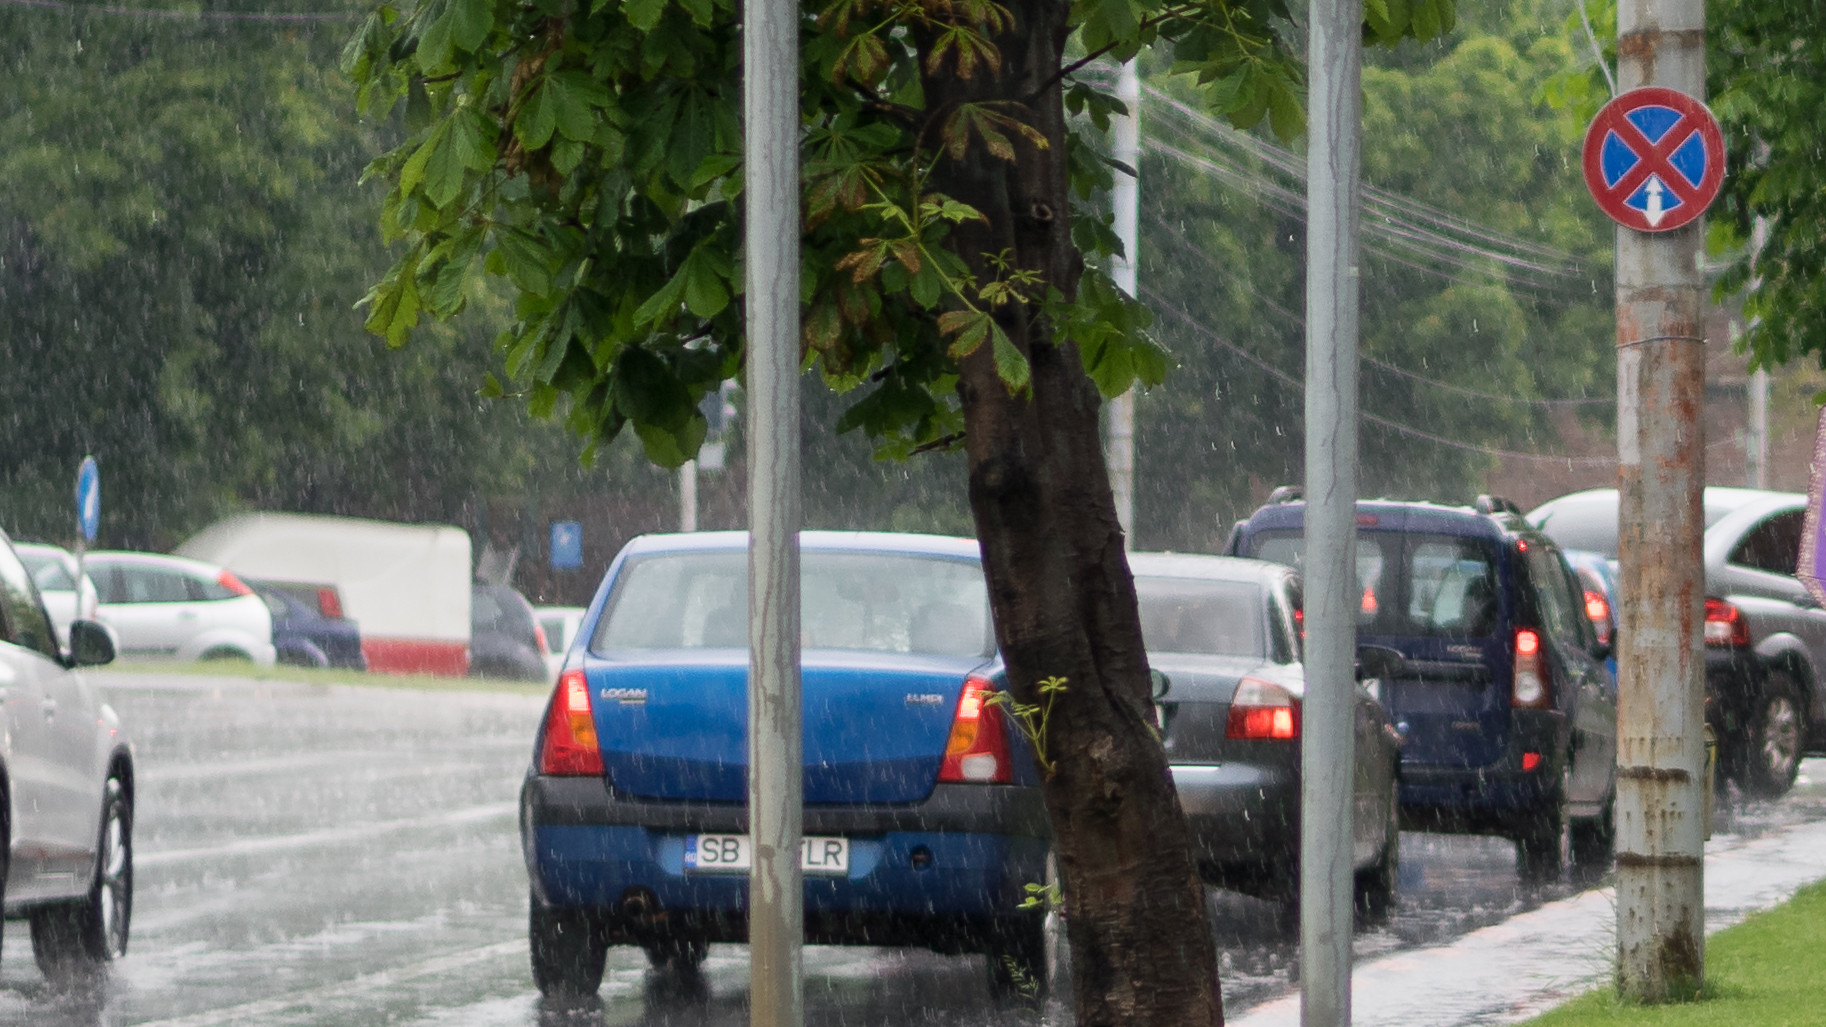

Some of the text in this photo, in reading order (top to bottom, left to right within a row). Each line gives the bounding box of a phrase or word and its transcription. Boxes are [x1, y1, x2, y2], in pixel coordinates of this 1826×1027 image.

[601, 688, 647, 698] LOGAN
[701, 837, 843, 866] SB LR
